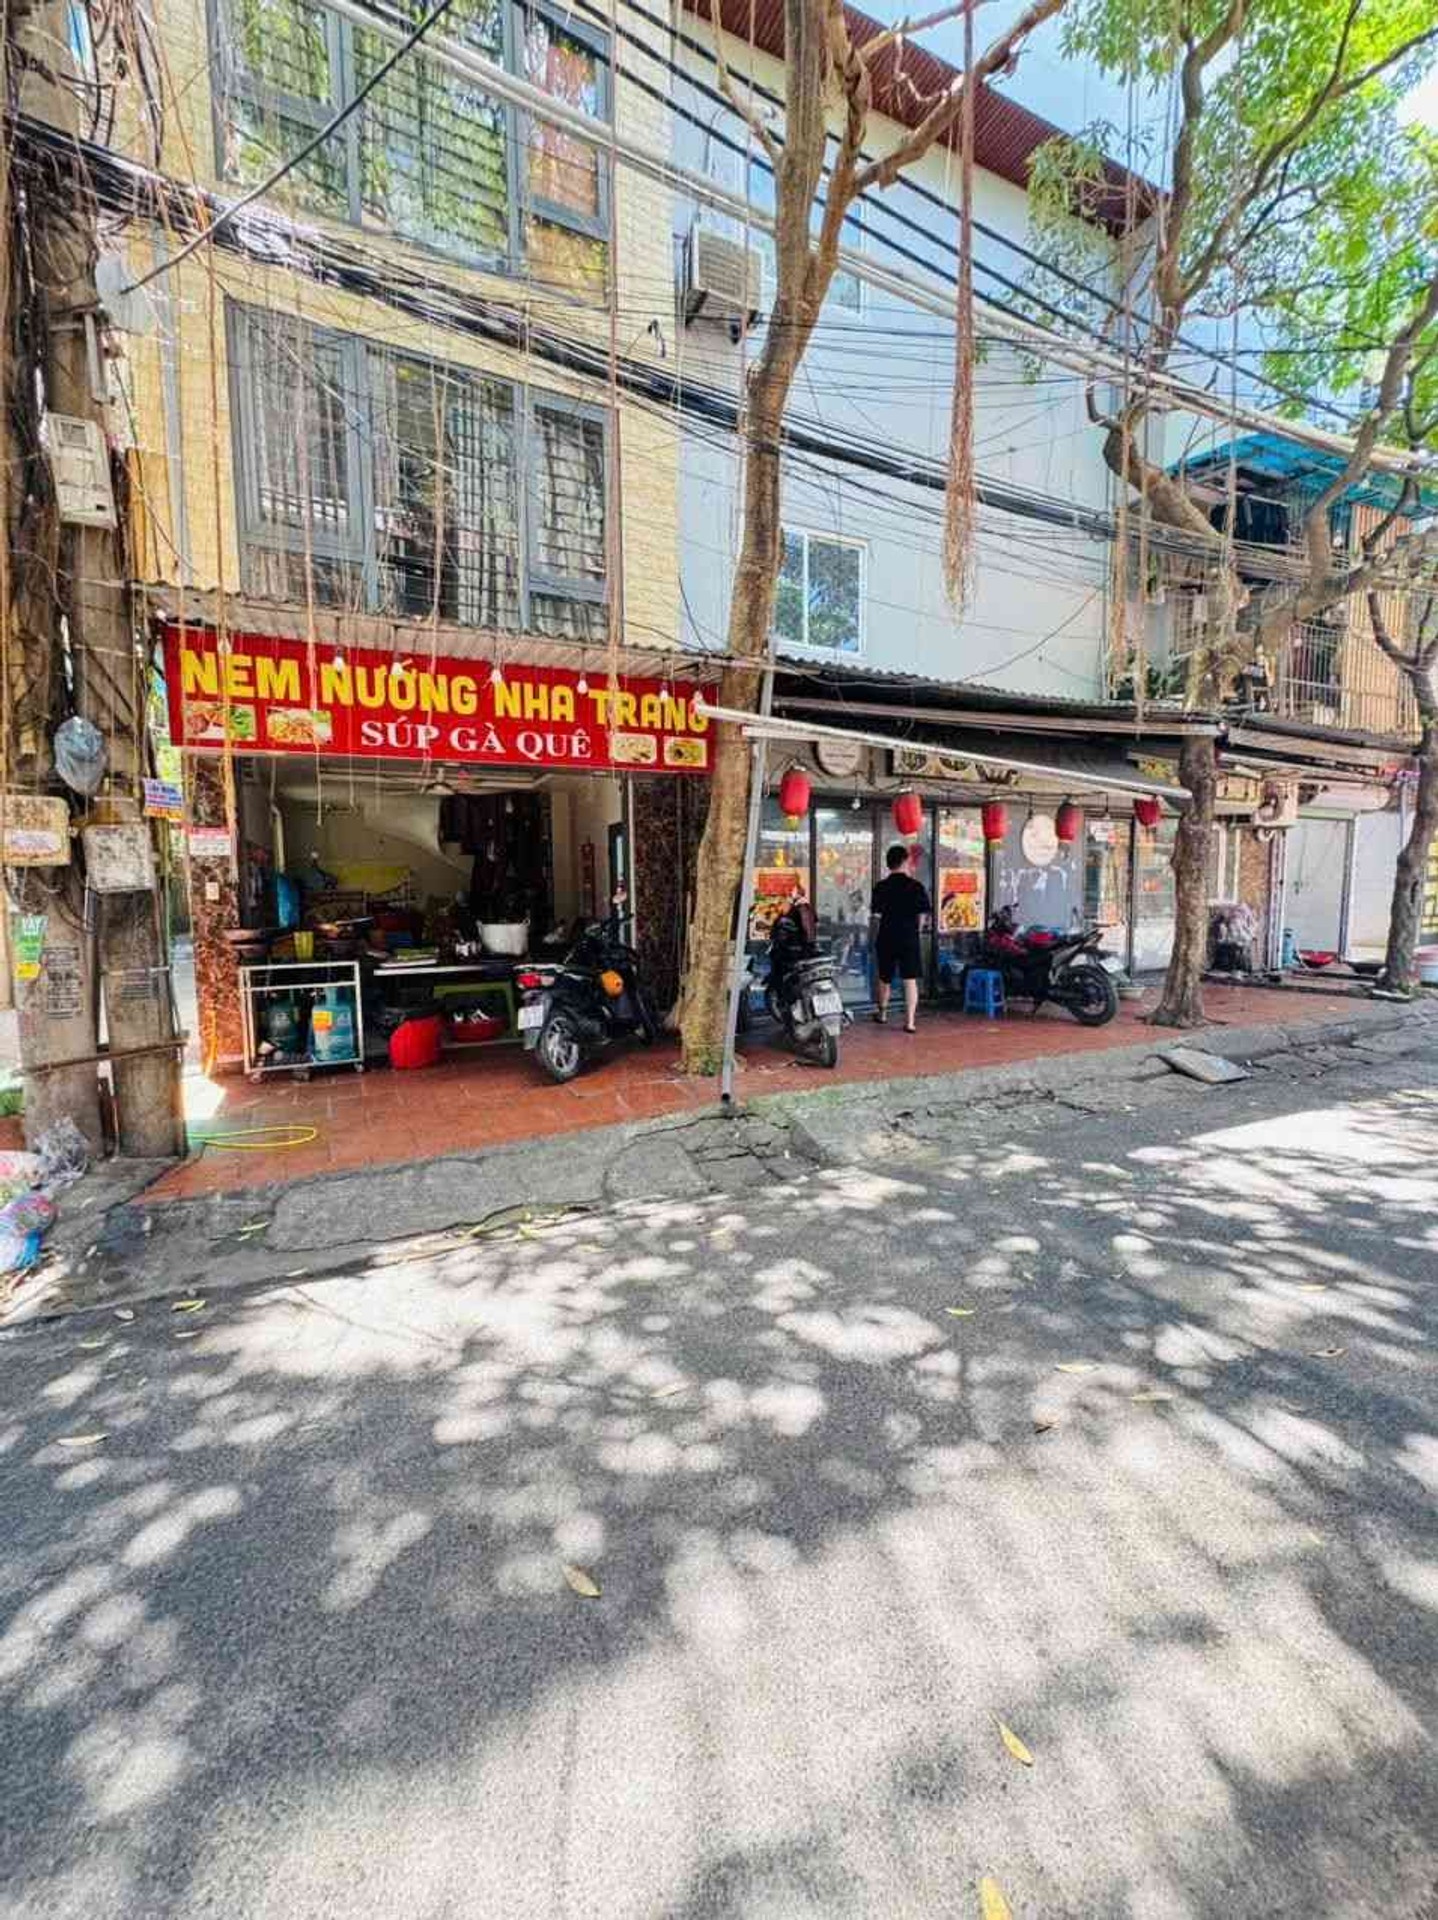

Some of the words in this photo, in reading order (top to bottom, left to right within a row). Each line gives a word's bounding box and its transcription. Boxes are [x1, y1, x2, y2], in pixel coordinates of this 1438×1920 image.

[181, 649, 300, 701] NEM
[320, 657, 478, 715] NƯỚNG
[495, 681, 575, 723] NHA
[588, 689, 709, 733] TRANG
[361, 716, 440, 750] SÚP
[450, 722, 506, 754] GÀ
[516, 728, 592, 761] QUÊ
